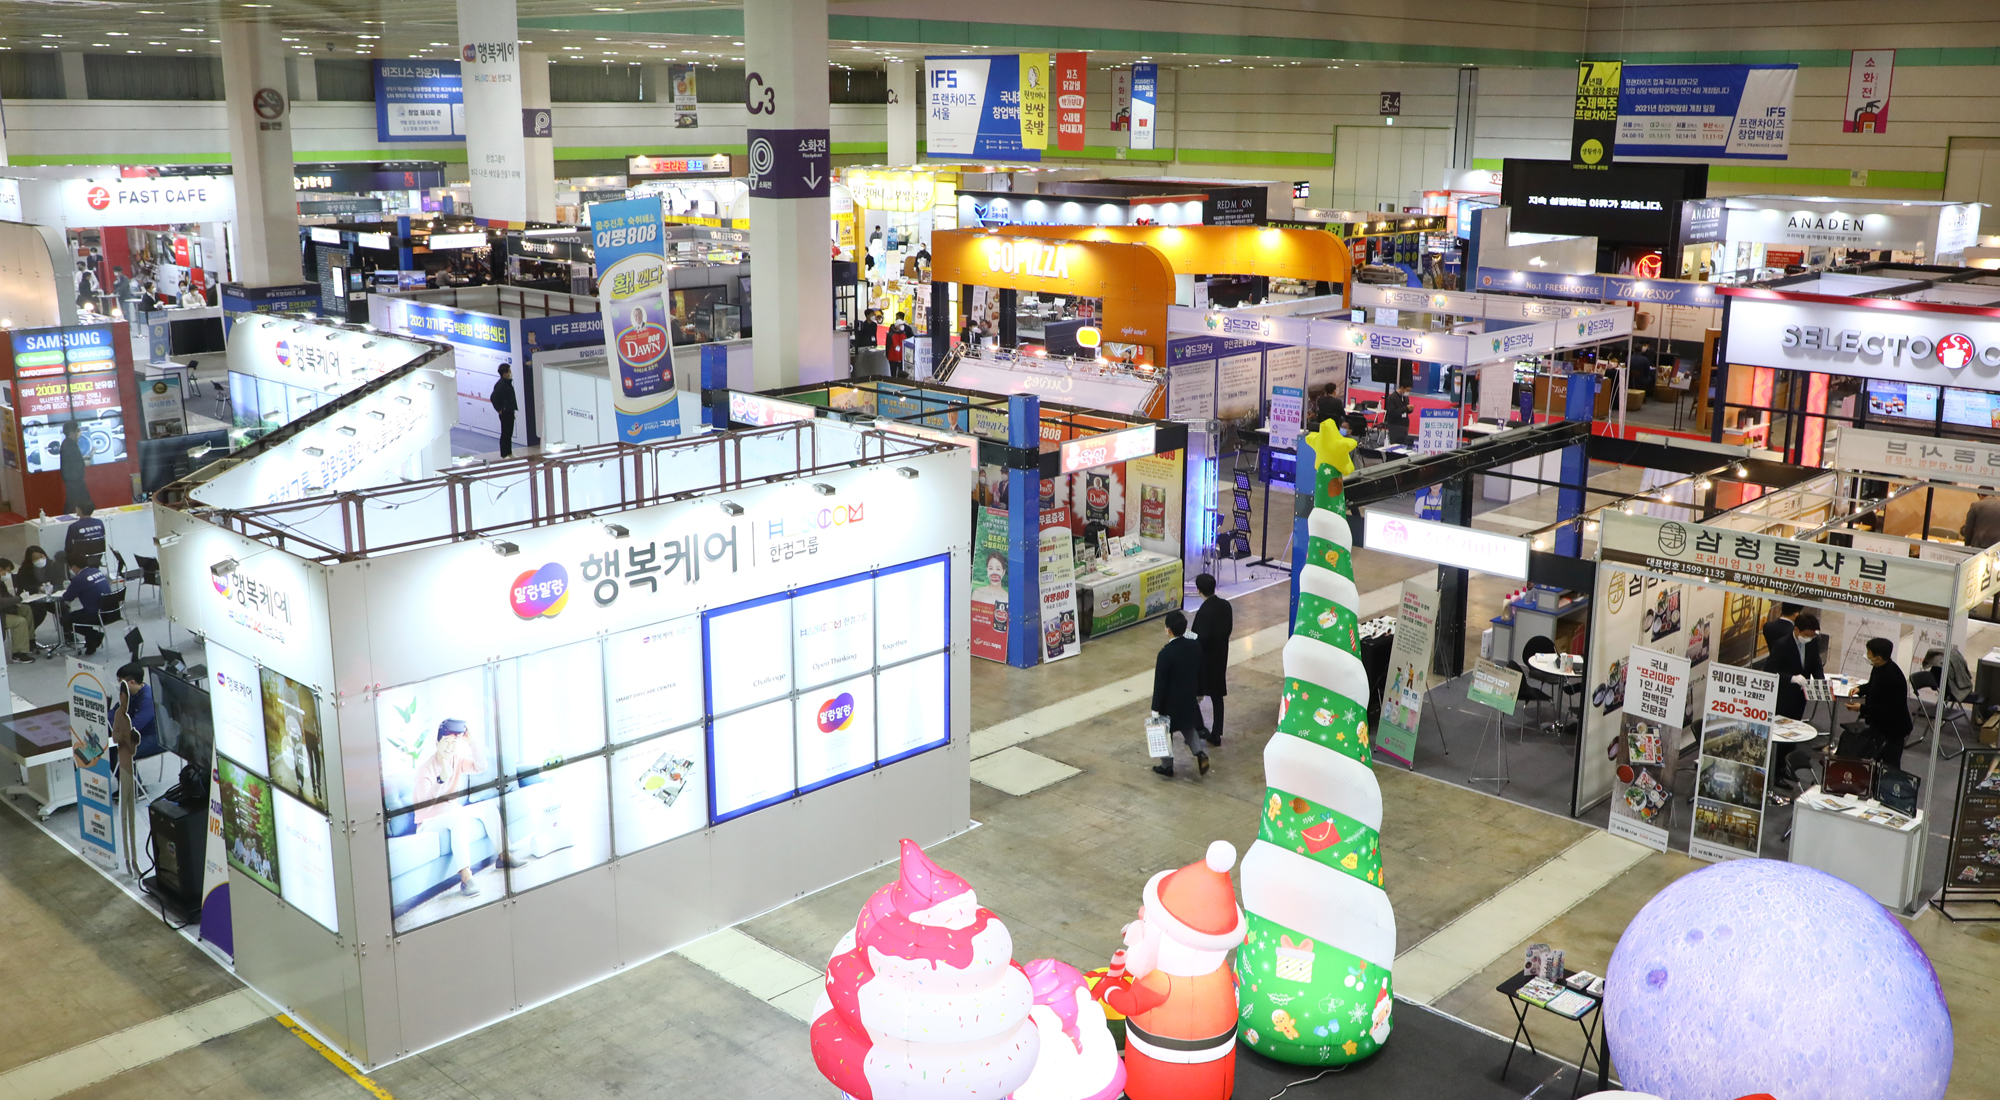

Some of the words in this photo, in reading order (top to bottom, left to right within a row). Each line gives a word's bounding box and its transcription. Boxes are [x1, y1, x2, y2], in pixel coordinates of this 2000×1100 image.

[477, 42, 515, 65] 행복케어
[382, 67, 415, 84] 비즈니스
[416, 68, 441, 85] 라운지
[931, 70, 957, 88] IFS
[1066, 69, 1078, 80] 치즈
[1580, 63, 1595, 86] 7
[1625, 78, 1653, 86] 프랜차이즈
[1665, 78, 1676, 86] 국내
[1676, 78, 1699, 86] 최대규모
[1861, 57, 1875, 99] 소화전
[745, 72, 775, 115] C3
[1063, 81, 1081, 91] 닭갈비
[1579, 87, 1591, 95] 지속
[1592, 87, 1606, 95] 성장
[1625, 86, 1636, 95] 창업
[1648, 86, 1665, 95] 박람회
[1692, 87, 1702, 95] 4회
[1702, 87, 1730, 95] 개최됩니다
[932, 93, 977, 106] 프랜차이즈
[1061, 97, 1082, 107] 박가부대
[1576, 97, 1618, 110] 수제맥주
[408, 109, 419, 117] 창업
[932, 107, 950, 120] 서울
[1025, 103, 1045, 118] 보쌈
[1575, 109, 1617, 121] 프랜차이즈
[1634, 104, 1657, 113] 2021년
[1657, 104, 1688, 113] 창업박람회
[1689, 104, 1702, 113] 개최
[1702, 104, 1716, 113] 일정
[1766, 107, 1786, 117] IFS
[1063, 113, 1081, 123] 수제햄
[1623, 121, 1633, 129] 서울
[1739, 118, 1785, 129] 프랜차이즈
[1024, 119, 1045, 136] 족발
[1059, 124, 1083, 134] 부대찌개
[1738, 129, 1784, 141] 창업박람회
[798, 139, 826, 152] 소화전
[118, 189, 159, 204] FAST
[166, 188, 208, 204] CAFE
[1528, 195, 1547, 205] 지속
[1549, 196, 1587, 207] 성장에는
[1588, 198, 1618, 209] 이유가
[1620, 200, 1664, 211] 있습니다.
[1217, 199, 1231, 210] RED
[1691, 206, 1721, 221] ANADEN
[596, 217, 625, 232] 음주전후
[627, 213, 656, 226] 숙취해소
[1787, 216, 1864, 232] ANADEN
[596, 223, 658, 249] 여명808
[988, 241, 1069, 280] GOPIZZA
[612, 269, 635, 295] 확!
[637, 264, 664, 288] 깬다
[1526, 281, 1542, 291] No.1
[1545, 284, 1570, 293] FRESH
[1571, 286, 1600, 296] COFFEE
[409, 315, 425, 328] 2021
[439, 317, 454, 334] IFS
[454, 321, 473, 338] 박람회
[474, 321, 507, 344] 신청센터
[551, 323, 569, 336] IFS
[1223, 316, 1270, 337] 월드크리닝
[1588, 318, 1615, 337] 월드크리닝
[26, 332, 100, 350] SAMSUNG
[647, 333, 661, 344] 808
[1369, 332, 1424, 355] 월드크리닝
[1503, 333, 1534, 353] 월드크리닝
[1780, 323, 1933, 361] SELECTO
[78, 348, 112, 364] DANUBE
[626, 340, 661, 360] DAWN
[1185, 342, 1213, 358] 월드크리닝
[293, 343, 343, 378] 행복케어
[1424, 422, 1454, 430] 월드크리닝
[768, 502, 865, 541] HNCOM
[769, 535, 820, 565] 한컴그룹
[1695, 529, 1889, 583] 삼청동샤브
[513, 577, 566, 605] 말랑말랑
[580, 525, 739, 608] 행복케어
[1694, 552, 1741, 570] 프리미엄
[1746, 561, 1766, 574] 1인
[1848, 578, 1887, 596] 전문점
[1645, 556, 1681, 571] 대표번호
[1681, 563, 1726, 579] 1599-1135
[1733, 572, 1768, 587] 홈페이지
[1769, 577, 1896, 610] http://premiumshabu.com
[231, 570, 293, 627] 행복케어
[1043, 589, 1070, 605] 여명808
[843, 612, 867, 628] 한컴그룹
[882, 639, 908, 652] Together
[812, 657, 829, 671] Open
[830, 652, 858, 667] Thinking
[1650, 658, 1668, 672] 국내
[226, 675, 254, 702] 행복케어
[753, 673, 786, 688] Challenge
[1639, 678, 1654, 692] 1인
[1654, 682, 1675, 699] 샤브,
[1711, 669, 1748, 688] 웨이팅
[1750, 677, 1775, 693] 신화
[616, 693, 633, 704] SMART
[656, 682, 678, 694] CENTER
[1718, 685, 1726, 694] 일
[1727, 686, 1737, 696] 10
[73, 695, 85, 707] 한컴
[84, 697, 105, 712] 말랑말랑
[1641, 690, 1669, 708] 편백찜
[74, 707, 97, 723] 행복펀드
[819, 704, 852, 725] 말랑말랑
[1640, 702, 1667, 719] 전문점
[1711, 699, 1768, 722] 250-300
[210, 815, 221, 837] VR
